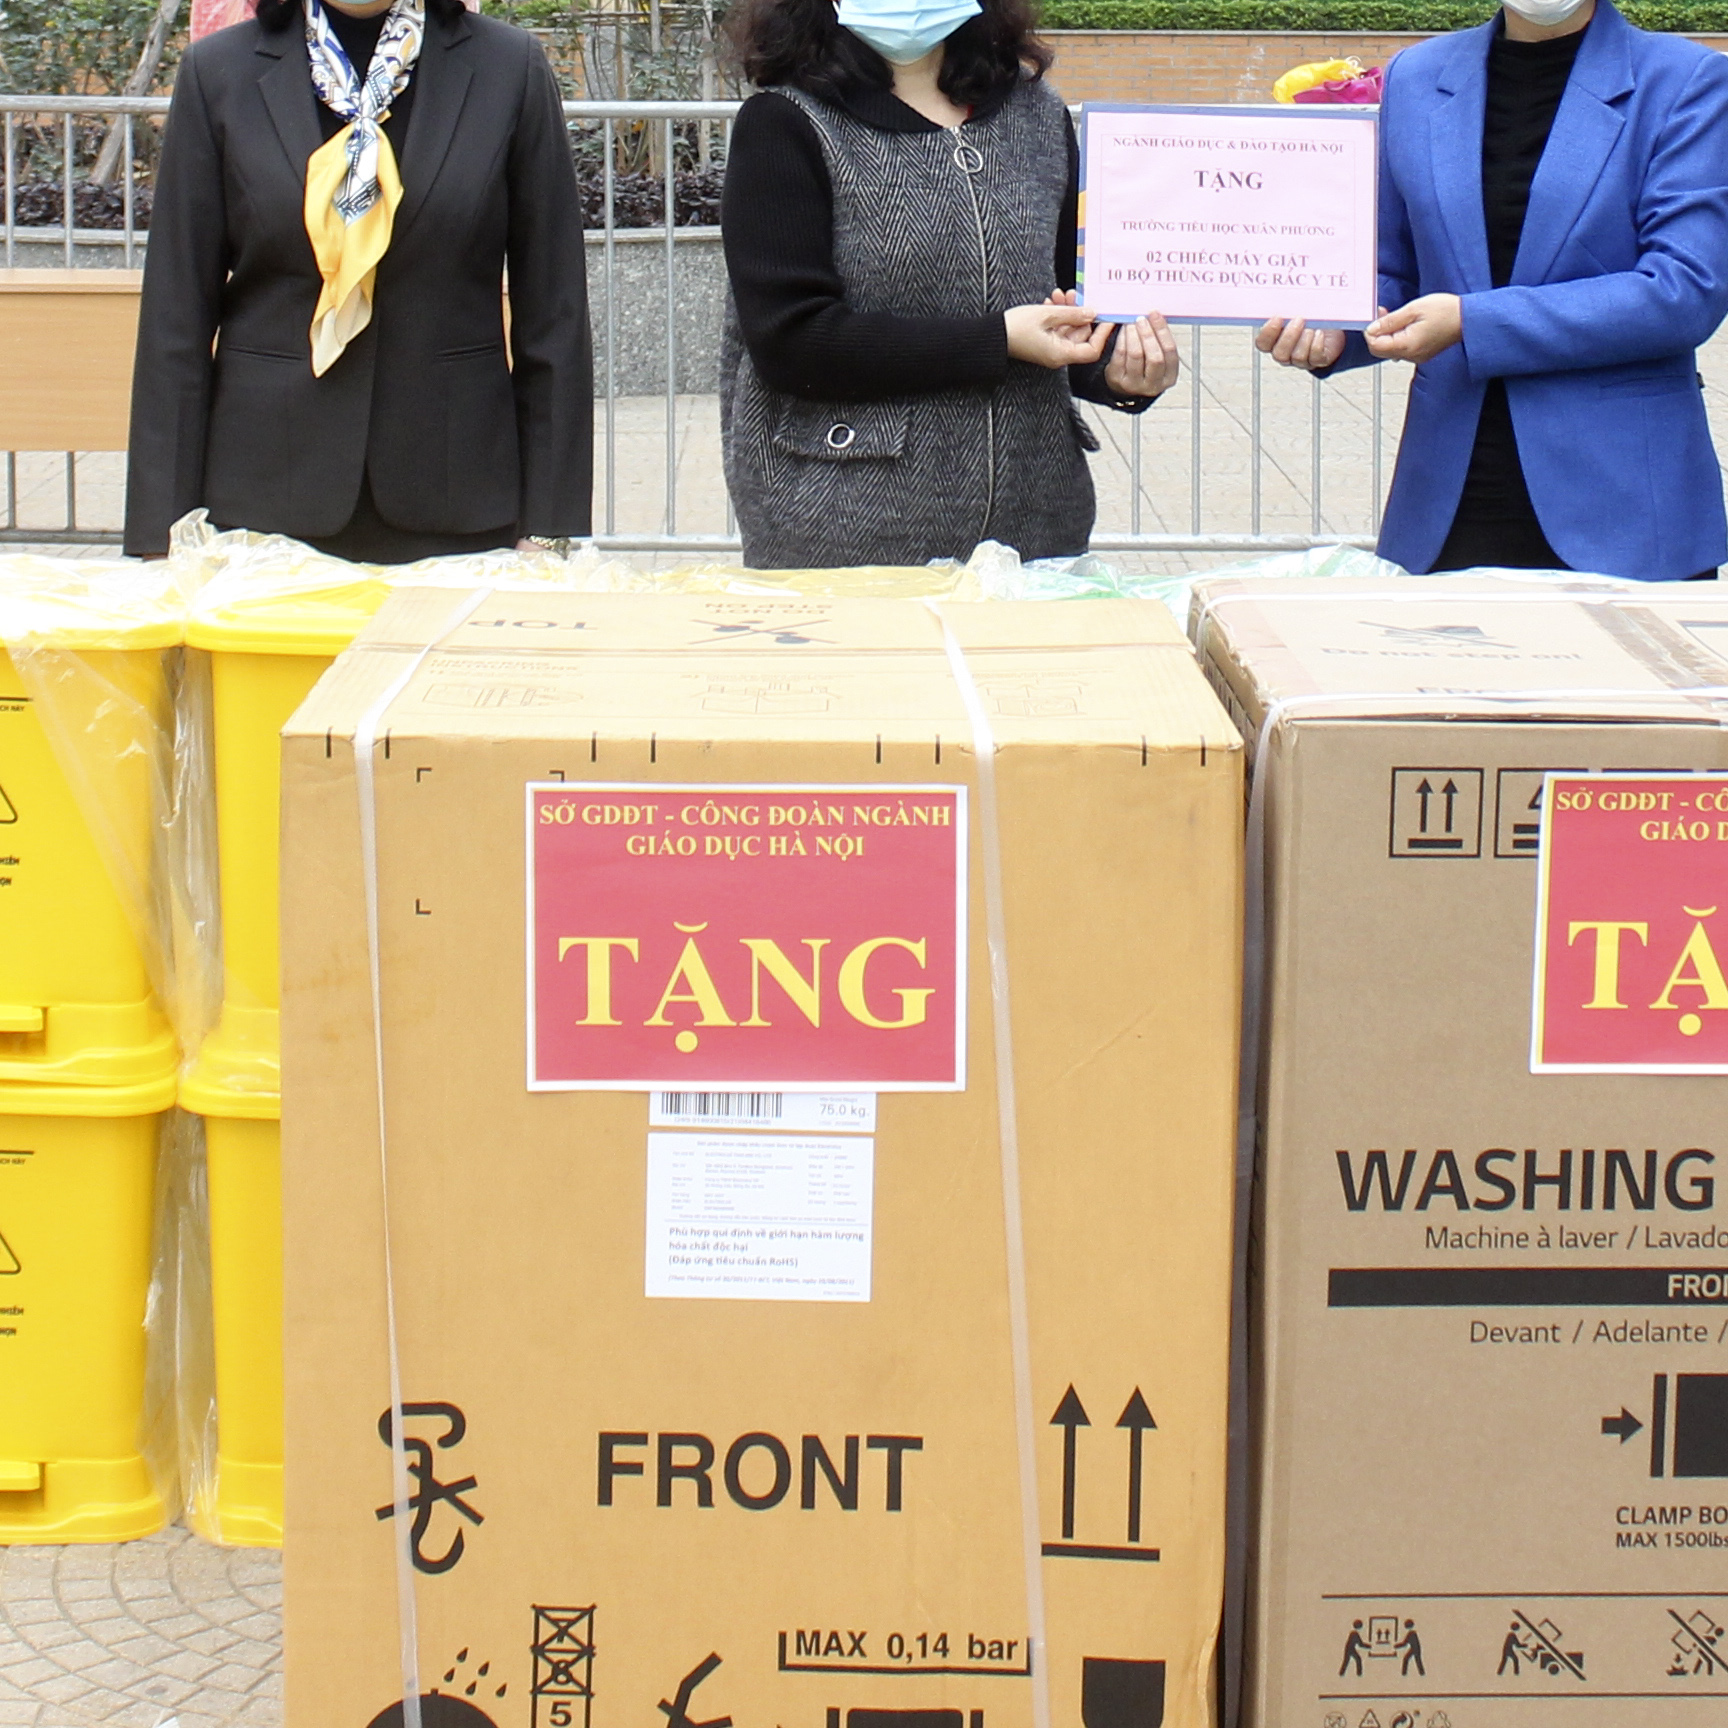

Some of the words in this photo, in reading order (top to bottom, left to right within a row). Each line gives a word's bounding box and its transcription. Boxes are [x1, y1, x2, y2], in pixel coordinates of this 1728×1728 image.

[1193, 167, 1263, 193] TẶNG
[1146, 250, 1162, 263] 02
[1167, 248, 1220, 265] CHIẾC
[1224, 250, 1264, 267] MÁY
[1267, 252, 1309, 269] GIẶT
[1107, 268, 1122, 281] 10
[1127, 268, 1150, 285] BỘ
[1156, 267, 1214, 284] THÙNG
[1219, 271, 1267, 287] ĐỰNG
[1272, 269, 1308, 287] RÁC
[1311, 273, 1324, 286] Y
[1327, 270, 1349, 287] TẾ
[539, 798, 576, 826] SỞ
[581, 804, 659, 827] GDĐT
[680, 800, 761, 827] CÔNG
[768, 800, 845, 827] ĐOÀN
[852, 802, 951, 827] NGÀNH
[1556, 788, 1593, 812] SỞ
[1598, 792, 1674, 812] GDĐT
[1639, 815, 1710, 841] GIÁO
[626, 831, 697, 857] GIÁO
[704, 836, 762, 861] DỤC
[768, 831, 808, 857] HÀ
[815, 835, 865, 861] NỘI
[558, 921, 936, 1053] TẶNG
[1337, 1149, 1715, 1213] WASHING
[1424, 1225, 1529, 1251] Machine
[1538, 1225, 1553, 1251] à
[1560, 1225, 1619, 1251] laver
[1469, 1321, 1562, 1344] Devant
[1593, 1320, 1709, 1344] Adelante
[596, 1430, 924, 1512] FRONT
[1615, 1505, 1693, 1525] CLAMP
[1615, 1531, 1658, 1549] MAX
[795, 1630, 868, 1659] MAX
[886, 1633, 950, 1664] 0,14
[968, 1633, 1018, 1661] bar
[550, 1701, 571, 1727] 5
